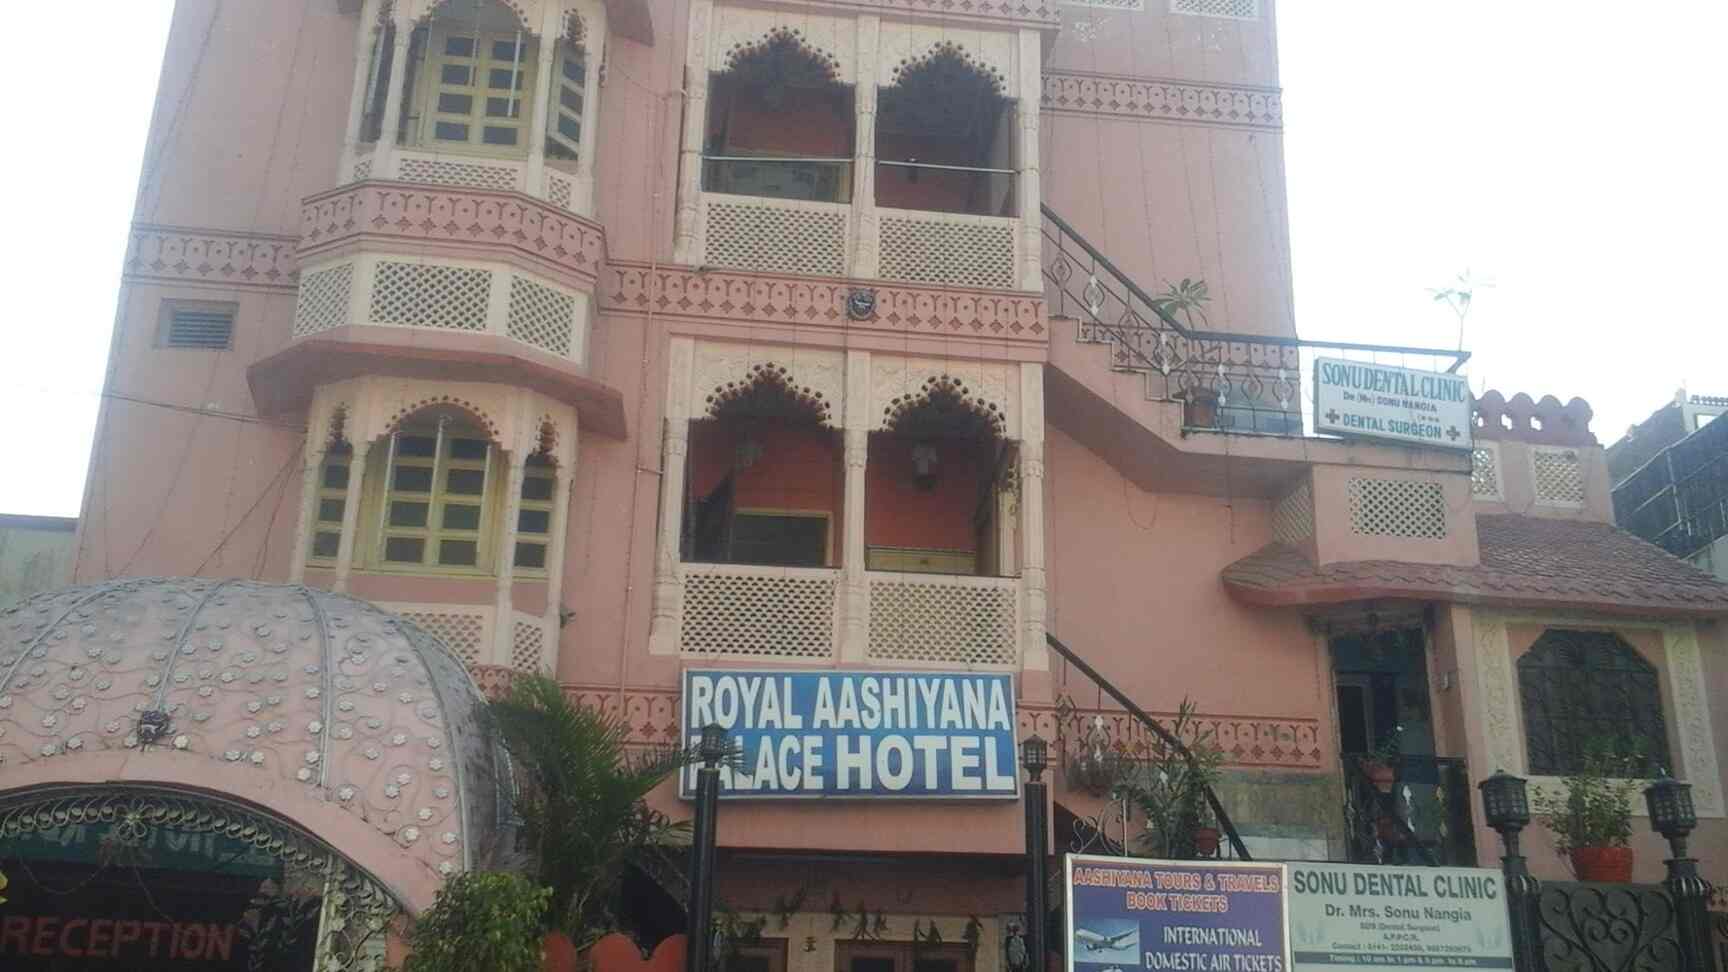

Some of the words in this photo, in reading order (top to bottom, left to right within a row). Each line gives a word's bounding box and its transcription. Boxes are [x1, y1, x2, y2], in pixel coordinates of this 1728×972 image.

[1322, 362, 1361, 389] SONU
[1364, 367, 1419, 398] DENTAL
[1421, 376, 1465, 403] CLINIC
[1343, 413, 1385, 432] DENTAL
[1388, 418, 1442, 440] SURGEON
[690, 675, 803, 730] ROYAL
[812, 676, 1011, 731] AASHIYANA
[836, 735, 1015, 791] HOTEL
[1154, 870, 1201, 891] TOURS
[1204, 873, 1216, 891] &
[1218, 873, 1281, 893] TRAVELS
[1294, 869, 1347, 895] SONU
[1354, 872, 1428, 898] DENTAL
[1433, 874, 1497, 900] CLINIC
[1126, 891, 1168, 912] BOOK
[1169, 892, 1229, 913] TICKETS
[1325, 903, 1345, 918] Dr.
[1349, 905, 1380, 919] Mrs.
[1384, 905, 1420, 919] Sonu
[1424, 907, 1472, 923] Nangia
[0, 915, 235, 962] RECEPTION
[1163, 925, 1263, 947] INTERNATIONAL
[1145, 951, 1209, 972] DOMESTIC
[1209, 953, 1231, 972] AIR
[1233, 953, 1282, 972] TICKETS
